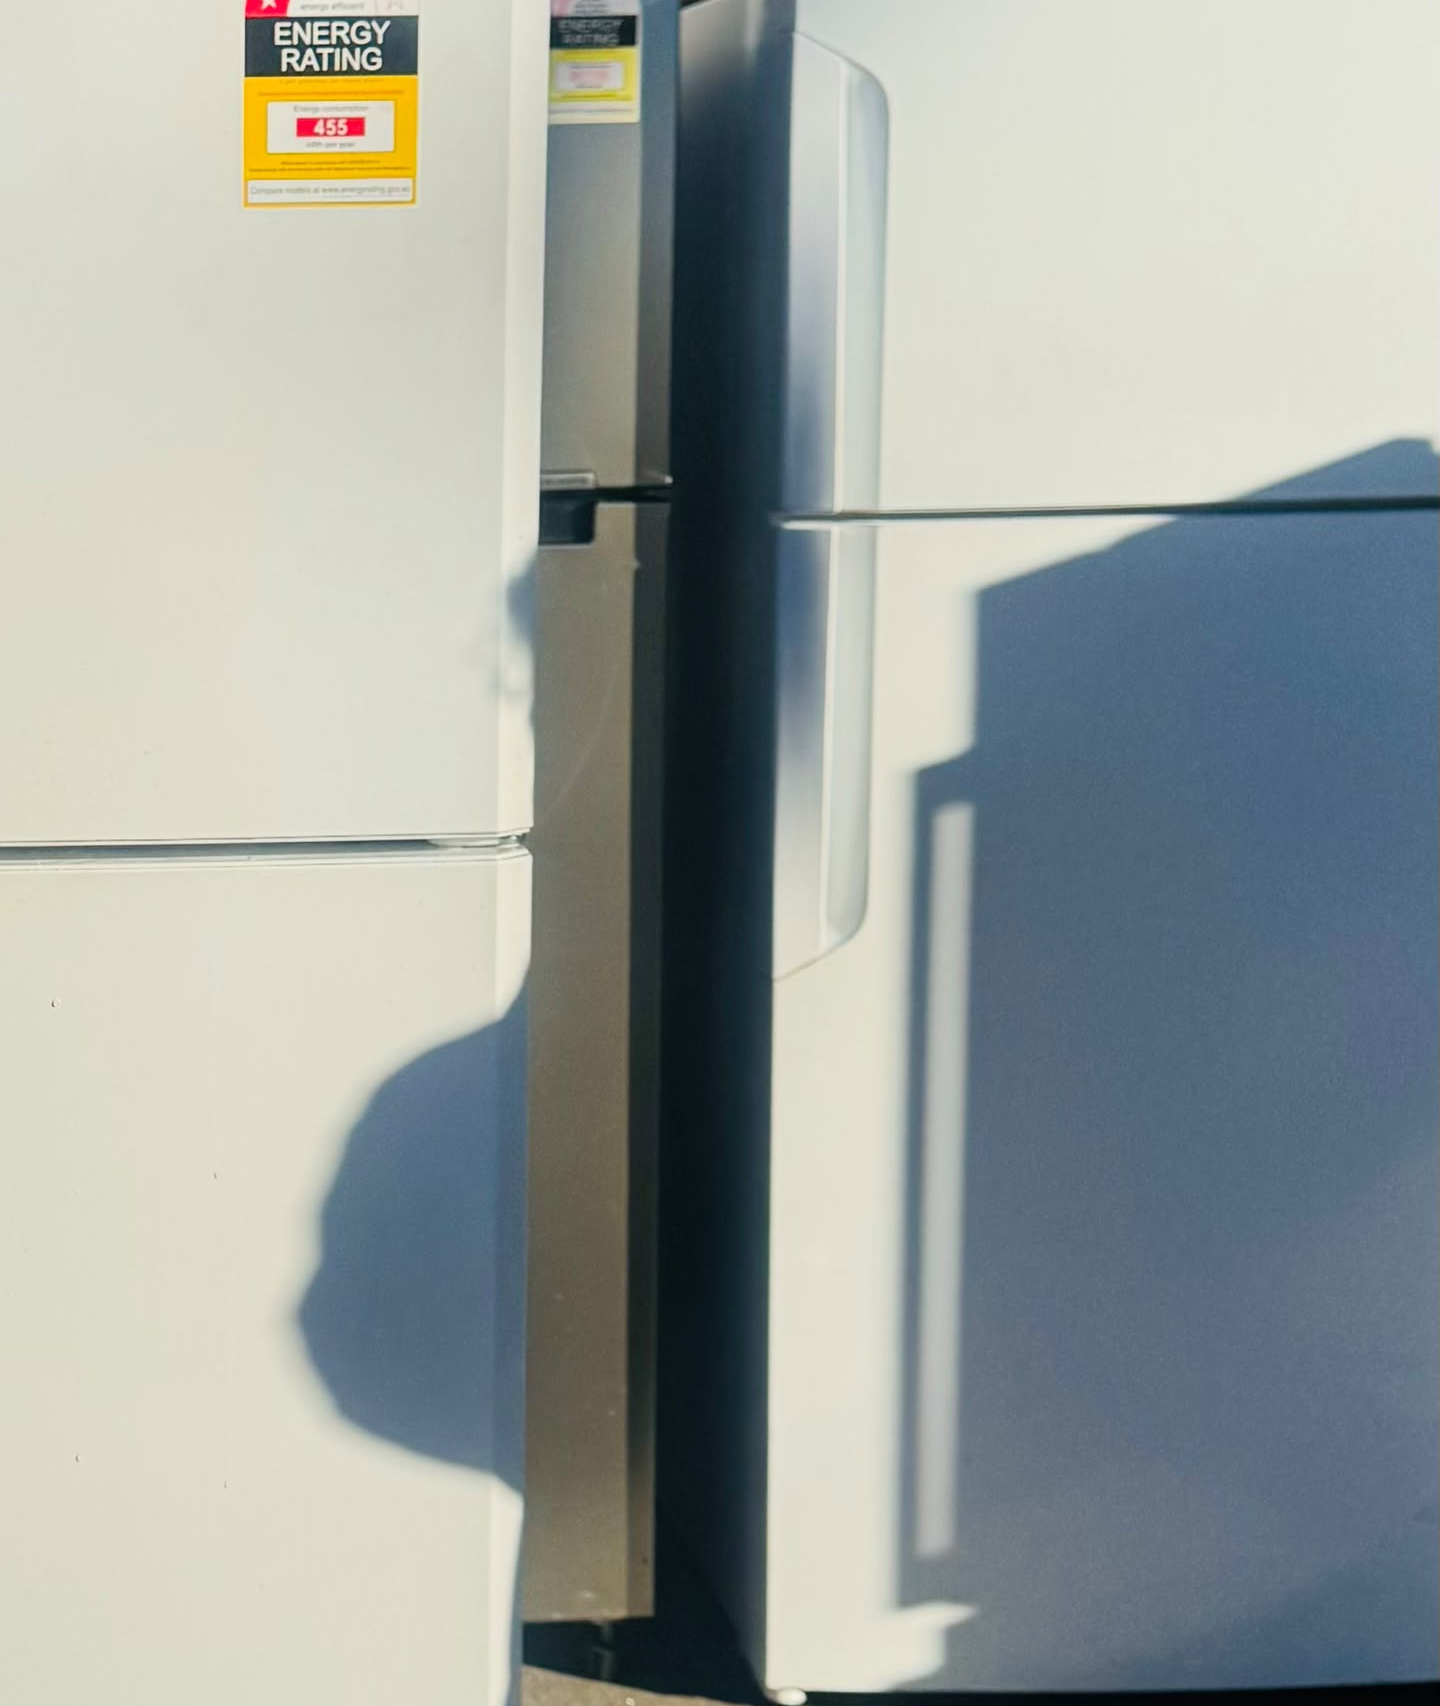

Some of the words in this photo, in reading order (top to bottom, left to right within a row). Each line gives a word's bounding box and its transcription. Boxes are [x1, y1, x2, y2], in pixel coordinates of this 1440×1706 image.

[274, 20, 391, 46] ENERGY
[281, 47, 383, 72] RATING
[314, 119, 348, 136] 455
